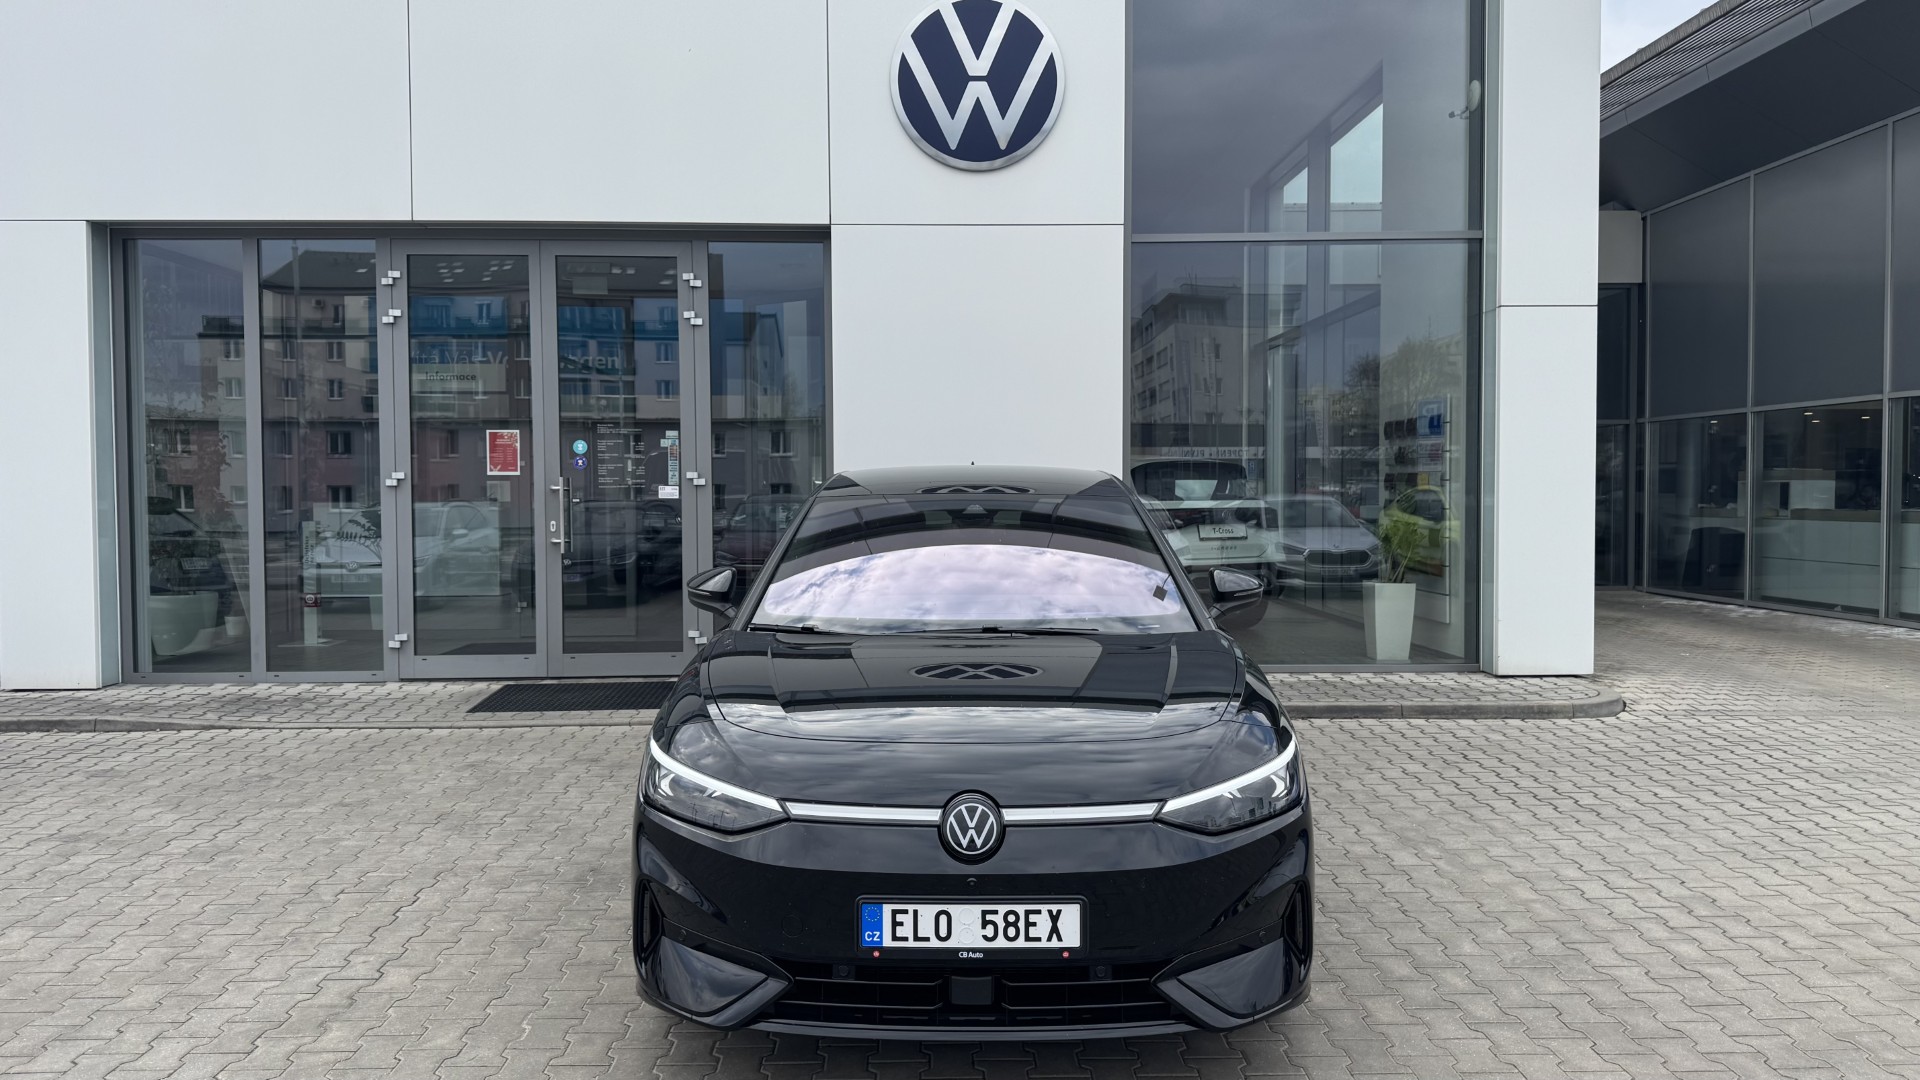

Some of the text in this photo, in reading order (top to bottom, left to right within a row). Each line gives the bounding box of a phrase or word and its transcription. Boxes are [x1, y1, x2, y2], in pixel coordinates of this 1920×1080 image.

[425, 371, 477, 381] Informace
[1212, 527, 1234, 535] T-Cross
[864, 931, 881, 942] CZ
[980, 908, 1064, 943] 58EX
